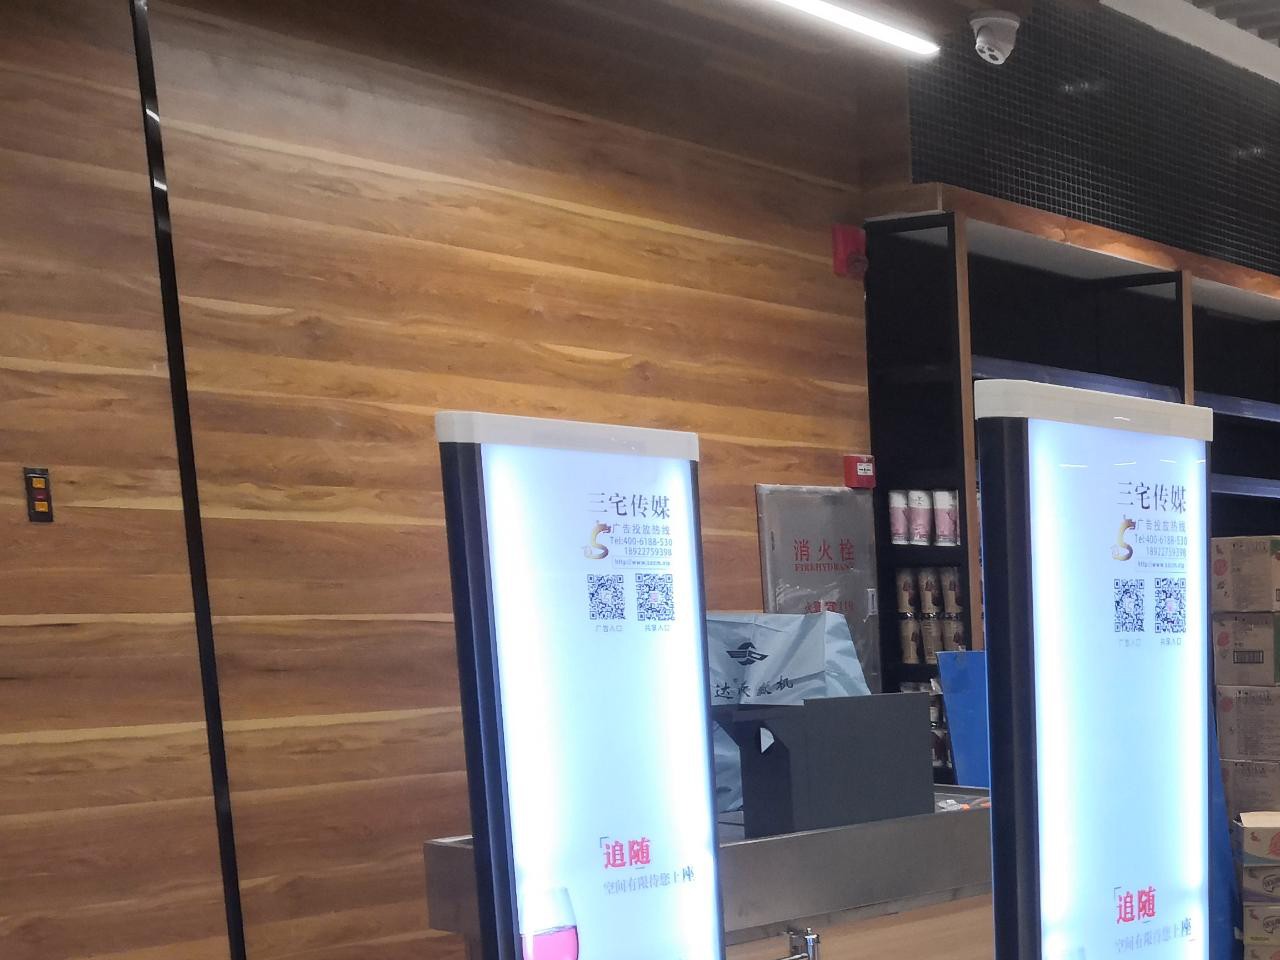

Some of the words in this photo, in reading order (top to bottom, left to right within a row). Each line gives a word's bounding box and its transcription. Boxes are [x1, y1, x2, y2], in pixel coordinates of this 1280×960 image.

[586, 492, 670, 519] 三宅传媒
[1116, 482, 1186, 514] 三宅传媒
[793, 538, 855, 562] 消火栓
